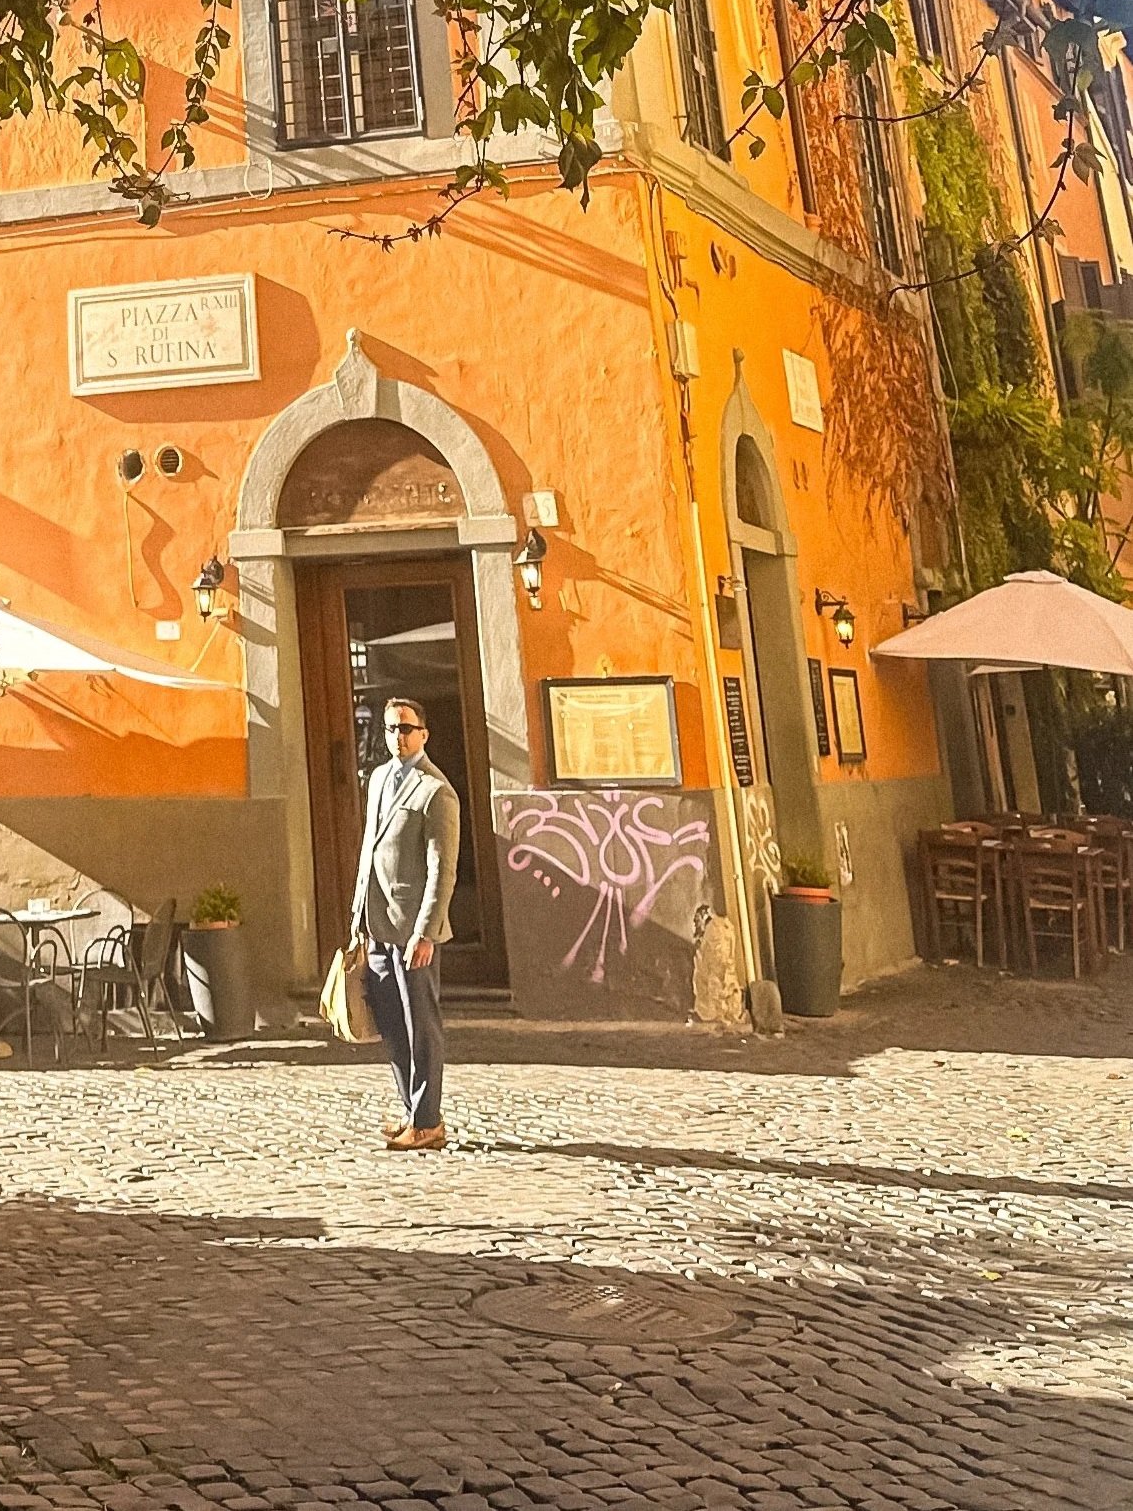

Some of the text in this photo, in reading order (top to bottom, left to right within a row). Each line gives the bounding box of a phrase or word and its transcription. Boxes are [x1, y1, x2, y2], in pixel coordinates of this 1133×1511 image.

[121, 303, 198, 327] PIAZZA
[152, 326, 169, 342] DI
[107, 341, 216, 368] S RUFINA
